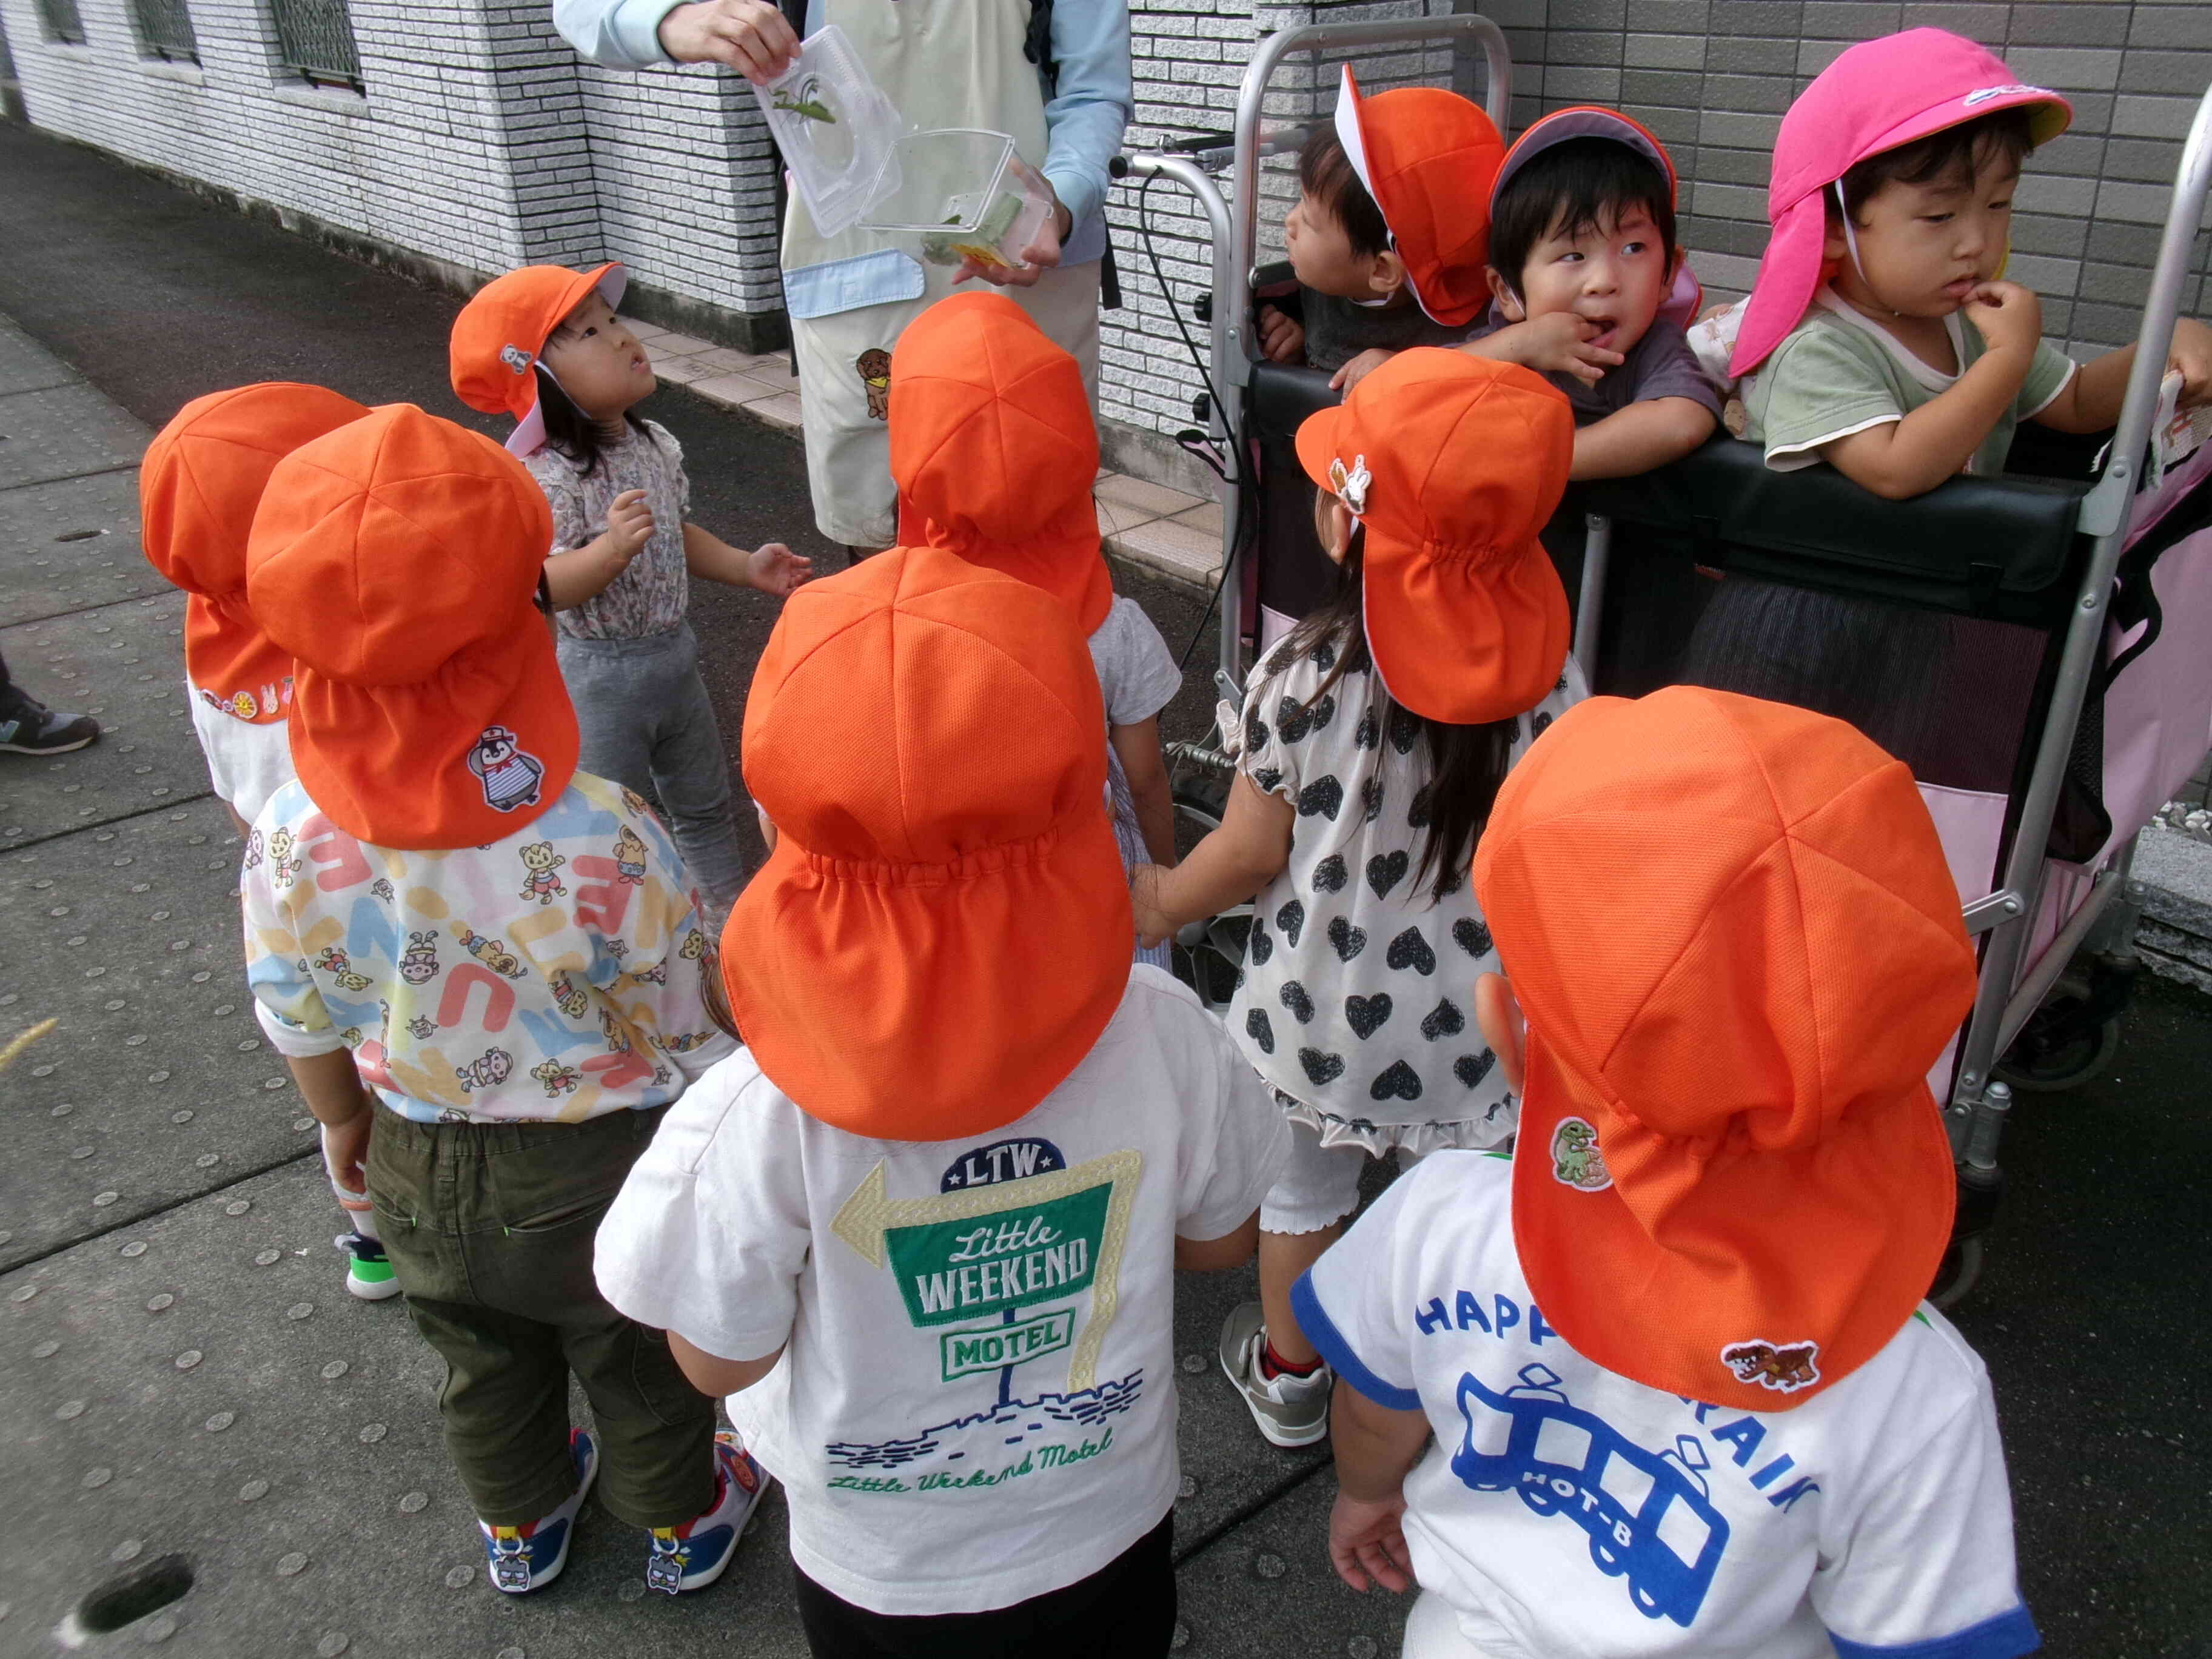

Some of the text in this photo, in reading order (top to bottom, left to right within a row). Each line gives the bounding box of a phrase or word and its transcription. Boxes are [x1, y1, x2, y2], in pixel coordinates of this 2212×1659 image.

[966, 1144, 1042, 1184] LTW
[949, 1215, 1062, 1262] Little
[916, 1238, 1088, 1314] WEEKEND
[953, 1321, 1064, 1367] MOTEL
[1415, 1290, 1558, 1346] HAPP
[826, 1427, 1113, 1492] Little Weekend Motel
[1522, 1471, 1632, 1547] HOT-B
